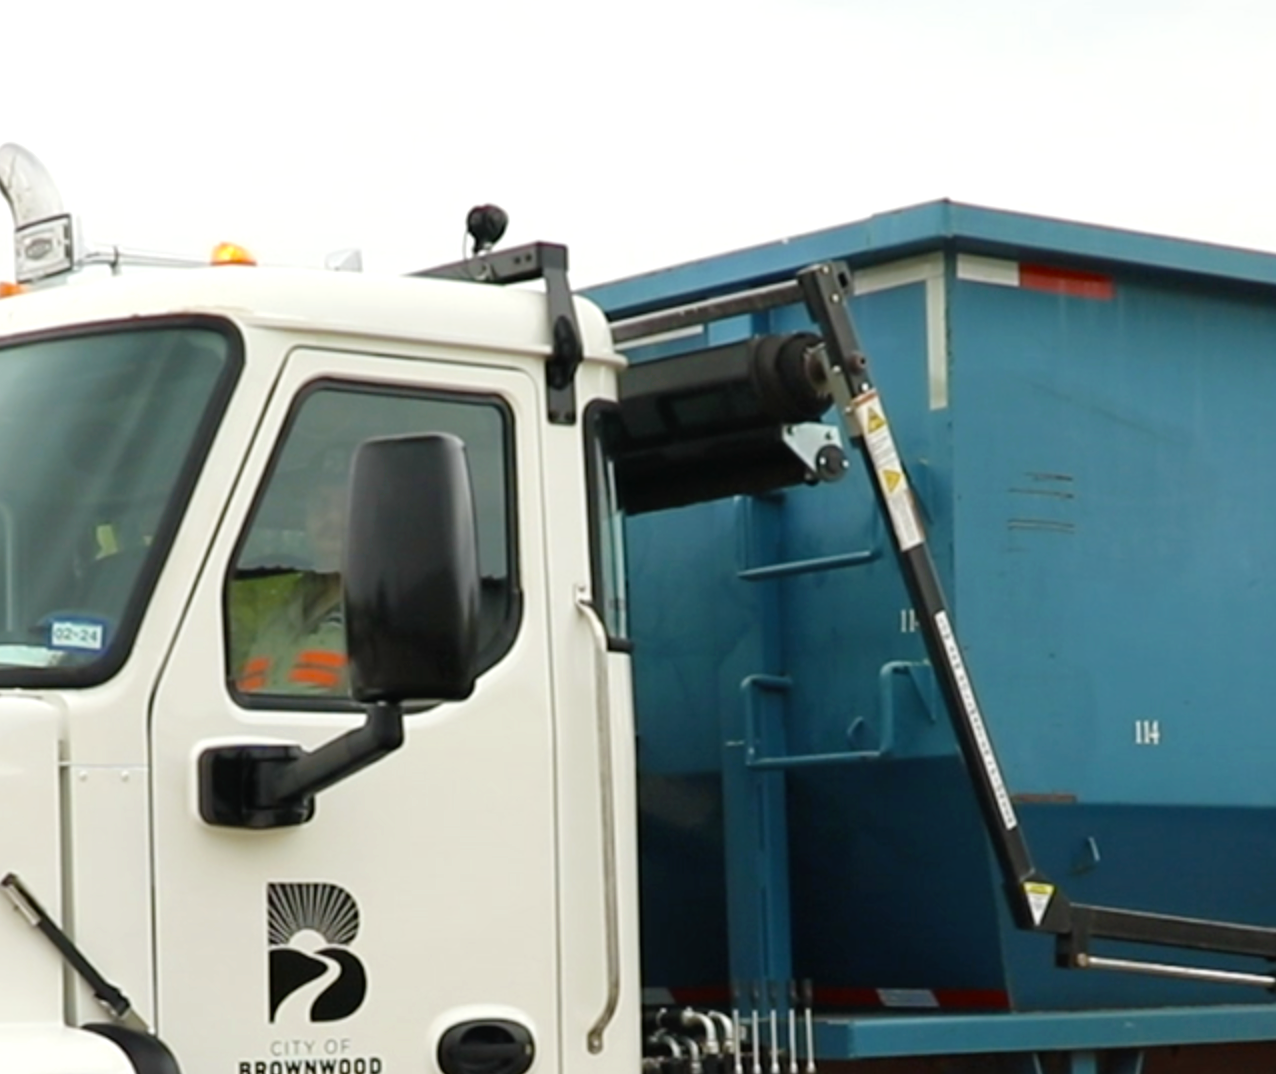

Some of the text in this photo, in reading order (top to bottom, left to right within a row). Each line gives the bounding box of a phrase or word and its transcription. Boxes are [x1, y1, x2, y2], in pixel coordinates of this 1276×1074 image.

[55, 626, 98, 643] 02-24
[1135, 719, 1161, 746] 114
[270, 1038, 351, 1057] CITY OF
